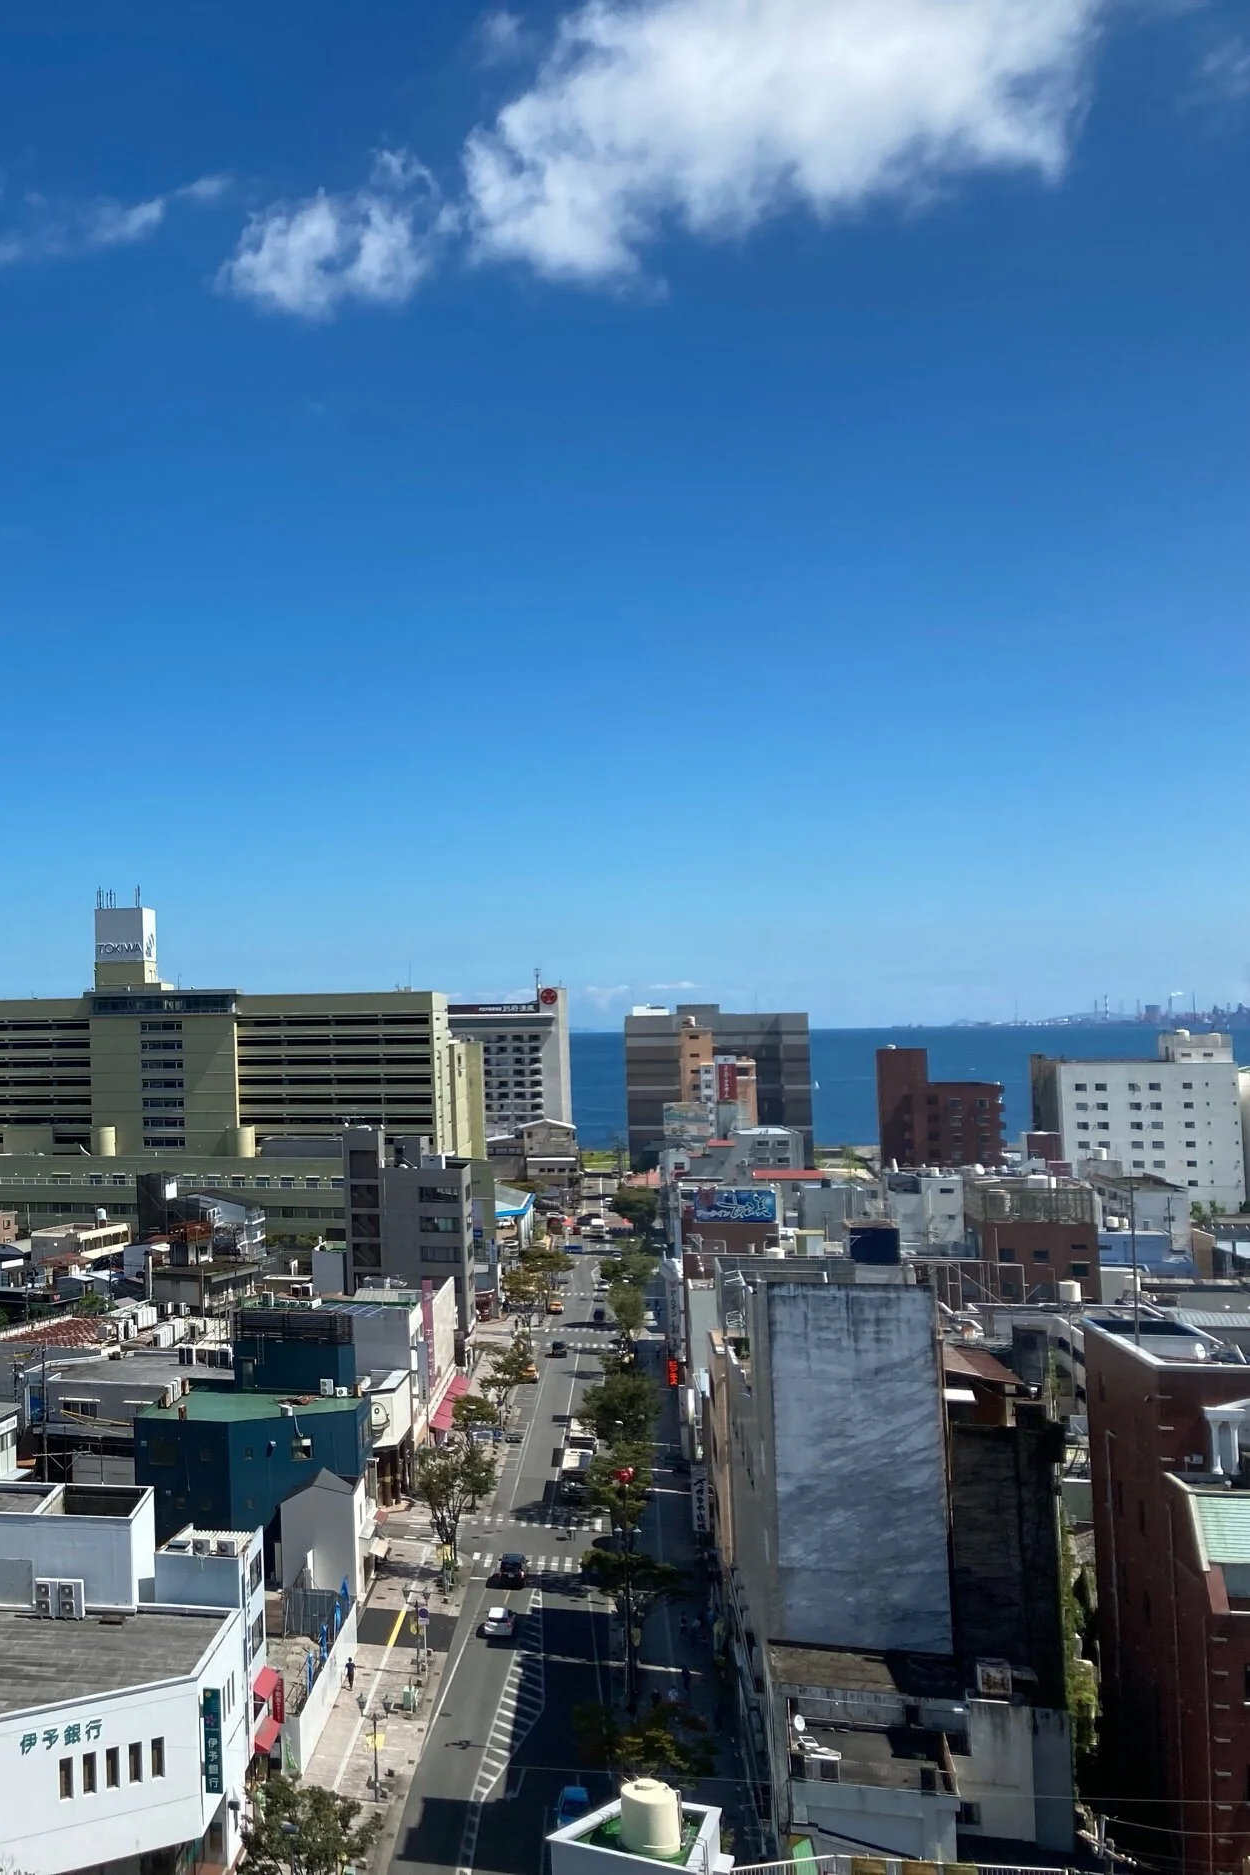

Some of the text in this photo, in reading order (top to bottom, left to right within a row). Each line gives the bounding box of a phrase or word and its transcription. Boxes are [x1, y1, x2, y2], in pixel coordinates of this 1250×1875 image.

[96, 942, 143, 954] TOKIWA
[20, 1719, 102, 1755] 伊予銀行
[208, 1738, 219, 1788] 伊予銀行
